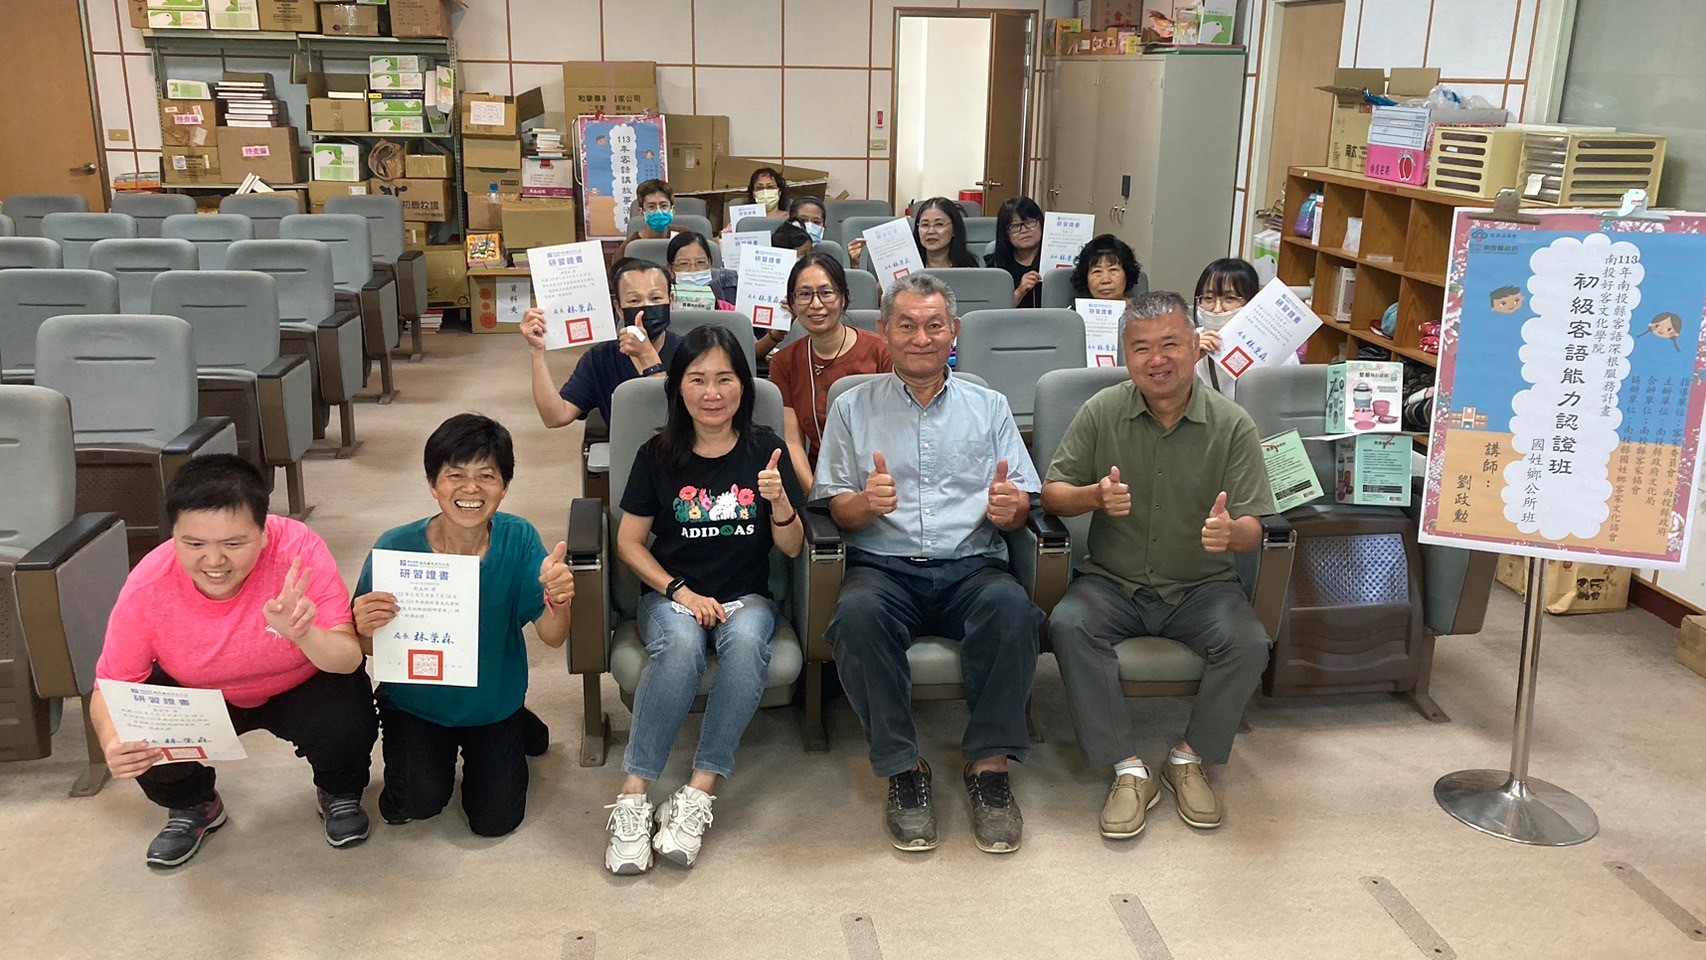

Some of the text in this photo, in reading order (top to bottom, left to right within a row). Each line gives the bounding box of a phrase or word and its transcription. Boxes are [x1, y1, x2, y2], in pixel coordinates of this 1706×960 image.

[1592, 254, 1619, 355] 南投好客文化學院
[1548, 272, 1600, 476] 初級客語能力認證班
[1452, 474, 1472, 524] 劉政勳
[1521, 438, 1546, 525] 國姓鄉公所班
[399, 568, 450, 581] 研習證書
[133, 694, 191, 706] 研習證書
